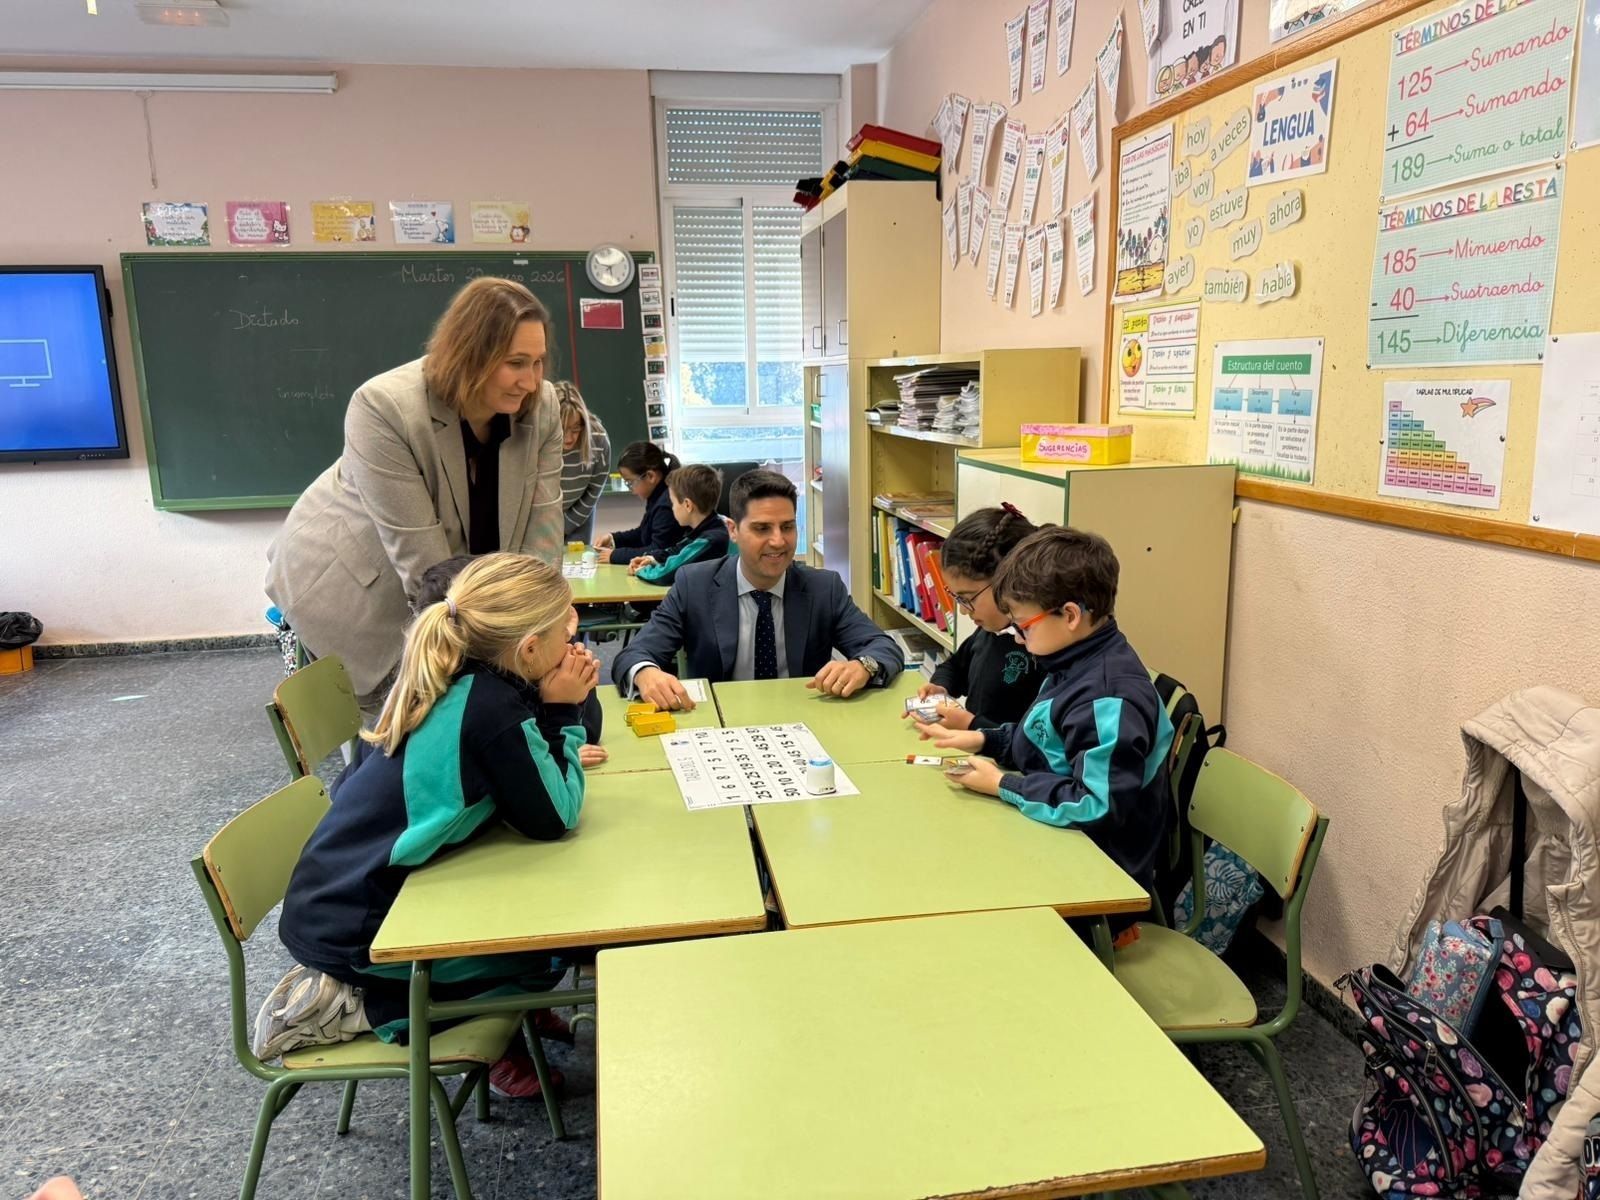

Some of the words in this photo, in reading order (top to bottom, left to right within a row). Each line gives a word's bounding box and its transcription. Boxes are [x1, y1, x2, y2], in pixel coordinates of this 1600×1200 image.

[1183, 17, 1195, 39] EN
[1198, 11, 1207, 30] TI
[1398, 9, 1470, 51] TÉRMINOS
[1474, 0, 1495, 20] DE
[1397, 66, 1433, 101] 125
[1469, 17, 1572, 72] Sumando
[1405, 107, 1430, 137] 64
[1464, 68, 1566, 118] Sumando
[1186, 126, 1206, 148] hoy
[1210, 149, 1217, 161] a
[1218, 116, 1247, 151] veces
[1262, 109, 1314, 147] LENGUA
[1391, 152, 1425, 184] 189
[1453, 145, 1499, 164] Suma
[1502, 140, 1514, 151] o
[1520, 116, 1564, 147] total
[1175, 166, 1189, 187] iba
[1193, 178, 1210, 199] voy
[1209, 195, 1243, 222] estuve
[1269, 195, 1301, 226] ahora
[1383, 199, 1452, 229] TÉRMINOS
[1456, 193, 1476, 212] DE
[1479, 191, 1499, 209] LA
[1503, 177, 1557, 204] RESTA
[1187, 224, 1198, 243] yo
[1232, 226, 1256, 252] muy
[1383, 248, 1417, 275] 185
[1454, 226, 1546, 259] Minuendo
[530, 270, 564, 283] 2026
[1167, 261, 1190, 284] ayer
[1261, 271, 1292, 294] había
[1204, 277, 1244, 294] también
[1390, 287, 1415, 311] 40
[1451, 272, 1544, 301] Sustraendo
[228, 305, 299, 330] Dictado
[1377, 329, 1412, 354] 145
[1443, 319, 1544, 352] Diferencia
[1227, 360, 1261, 371] Estructura
[1263, 360, 1275, 371] del
[1276, 360, 1303, 371] cuento
[1441, 388, 1474, 396] MULTIPLICAR
[1038, 442, 1088, 453] SUGERENCIAS
[755, 743, 769, 751] 45
[745, 771, 760, 779] 25
[755, 790, 772, 799] 25
[784, 788, 800, 796] 50
